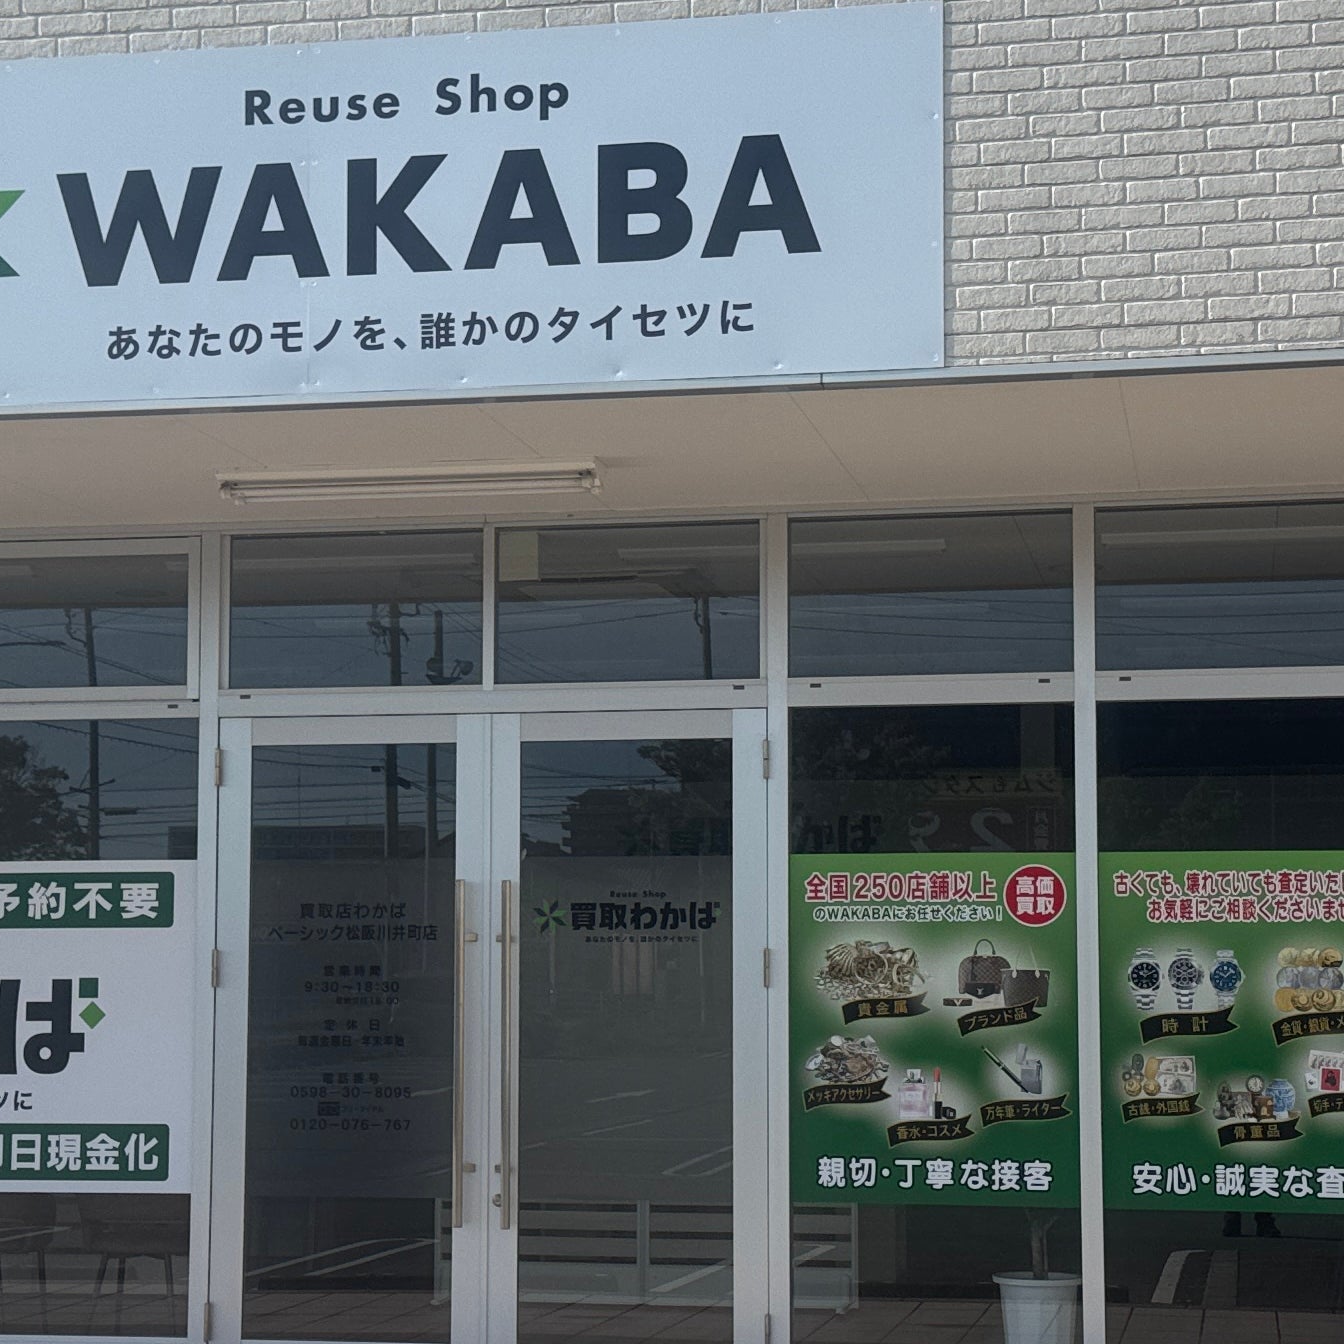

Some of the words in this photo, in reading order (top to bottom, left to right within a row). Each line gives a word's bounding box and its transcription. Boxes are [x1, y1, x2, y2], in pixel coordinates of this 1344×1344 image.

[244, 86, 402, 127] Reuse
[435, 73, 572, 122] Shop
[56, 134, 823, 287] WAKABA
[105, 298, 757, 361] あなたのモノを、誰かのタイセツに
[805, 872, 997, 902] 全国250店舗以上
[1015, 875, 1054, 895] 高価
[299, 902, 408, 920] 買取店わかば
[569, 900, 721, 931] 買取わかば
[1016, 897, 1056, 916] 買取
[267, 923, 439, 942] ベーシック松阪川井町店
[857, 999, 909, 1018] 貴金属
[963, 1006, 1028, 1031] ブランド品
[1161, 1017, 1210, 1035] 時計
[806, 1087, 881, 1105] メッキアクセサリー
[895, 1122, 963, 1140] 香水・コスメ
[816, 1156, 1054, 1191] 親切・丁寧な接客
